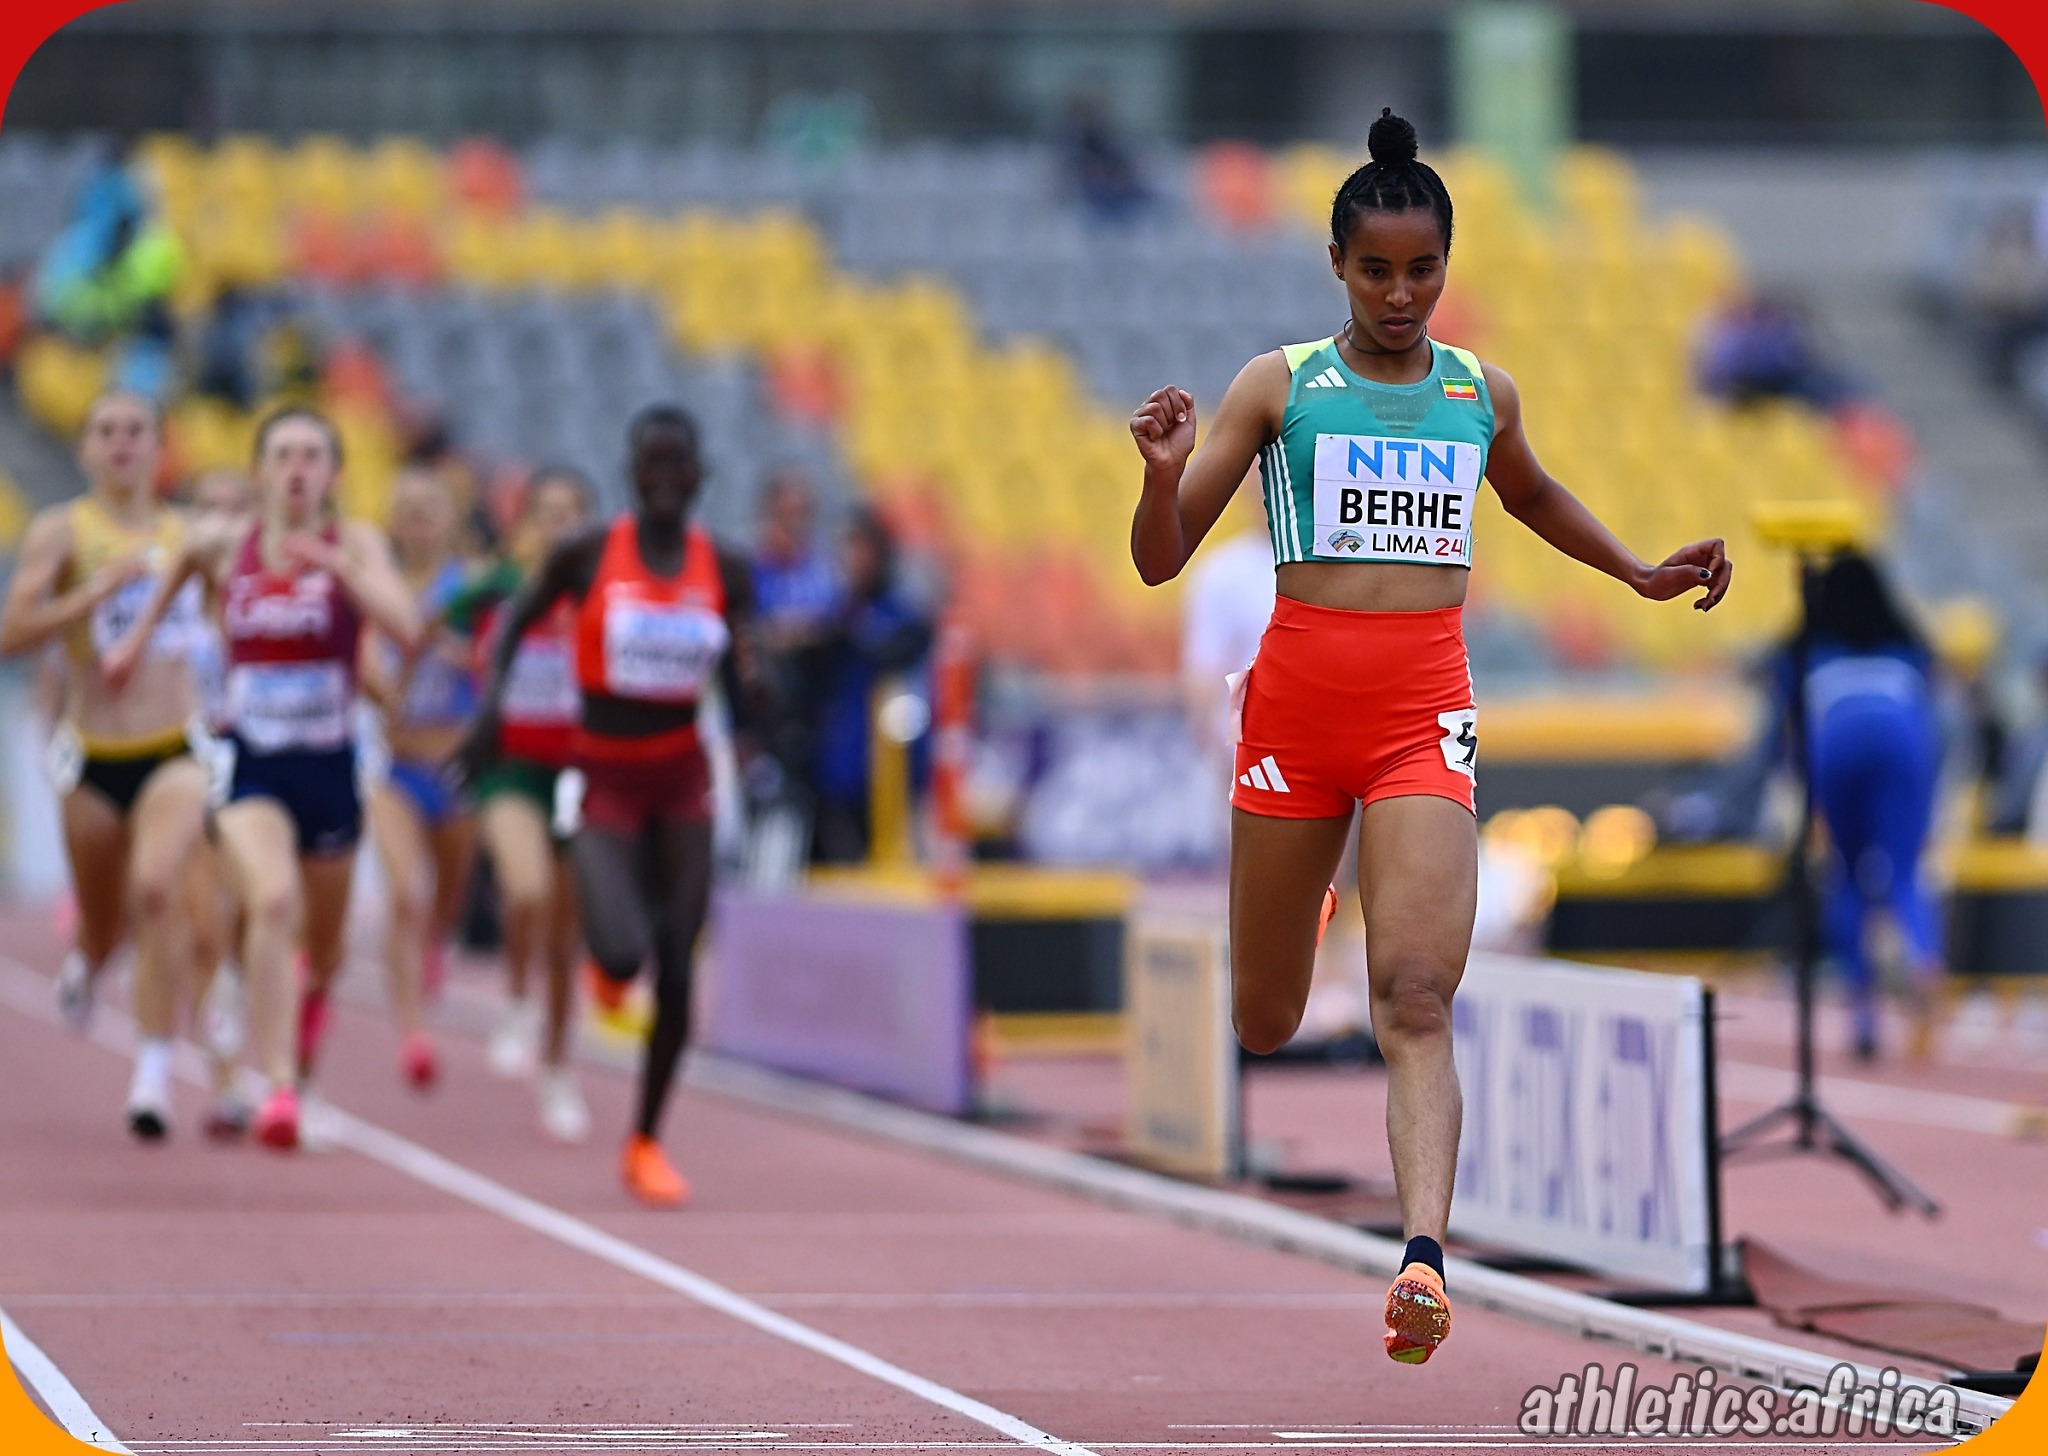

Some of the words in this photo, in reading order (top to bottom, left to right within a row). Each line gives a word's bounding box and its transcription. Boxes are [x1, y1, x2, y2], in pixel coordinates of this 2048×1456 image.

[1347, 438, 1456, 484] NTN
[1339, 488, 1463, 530] BERHE
[1371, 533, 1429, 555] LIMA
[1435, 537, 1463, 557] 24
